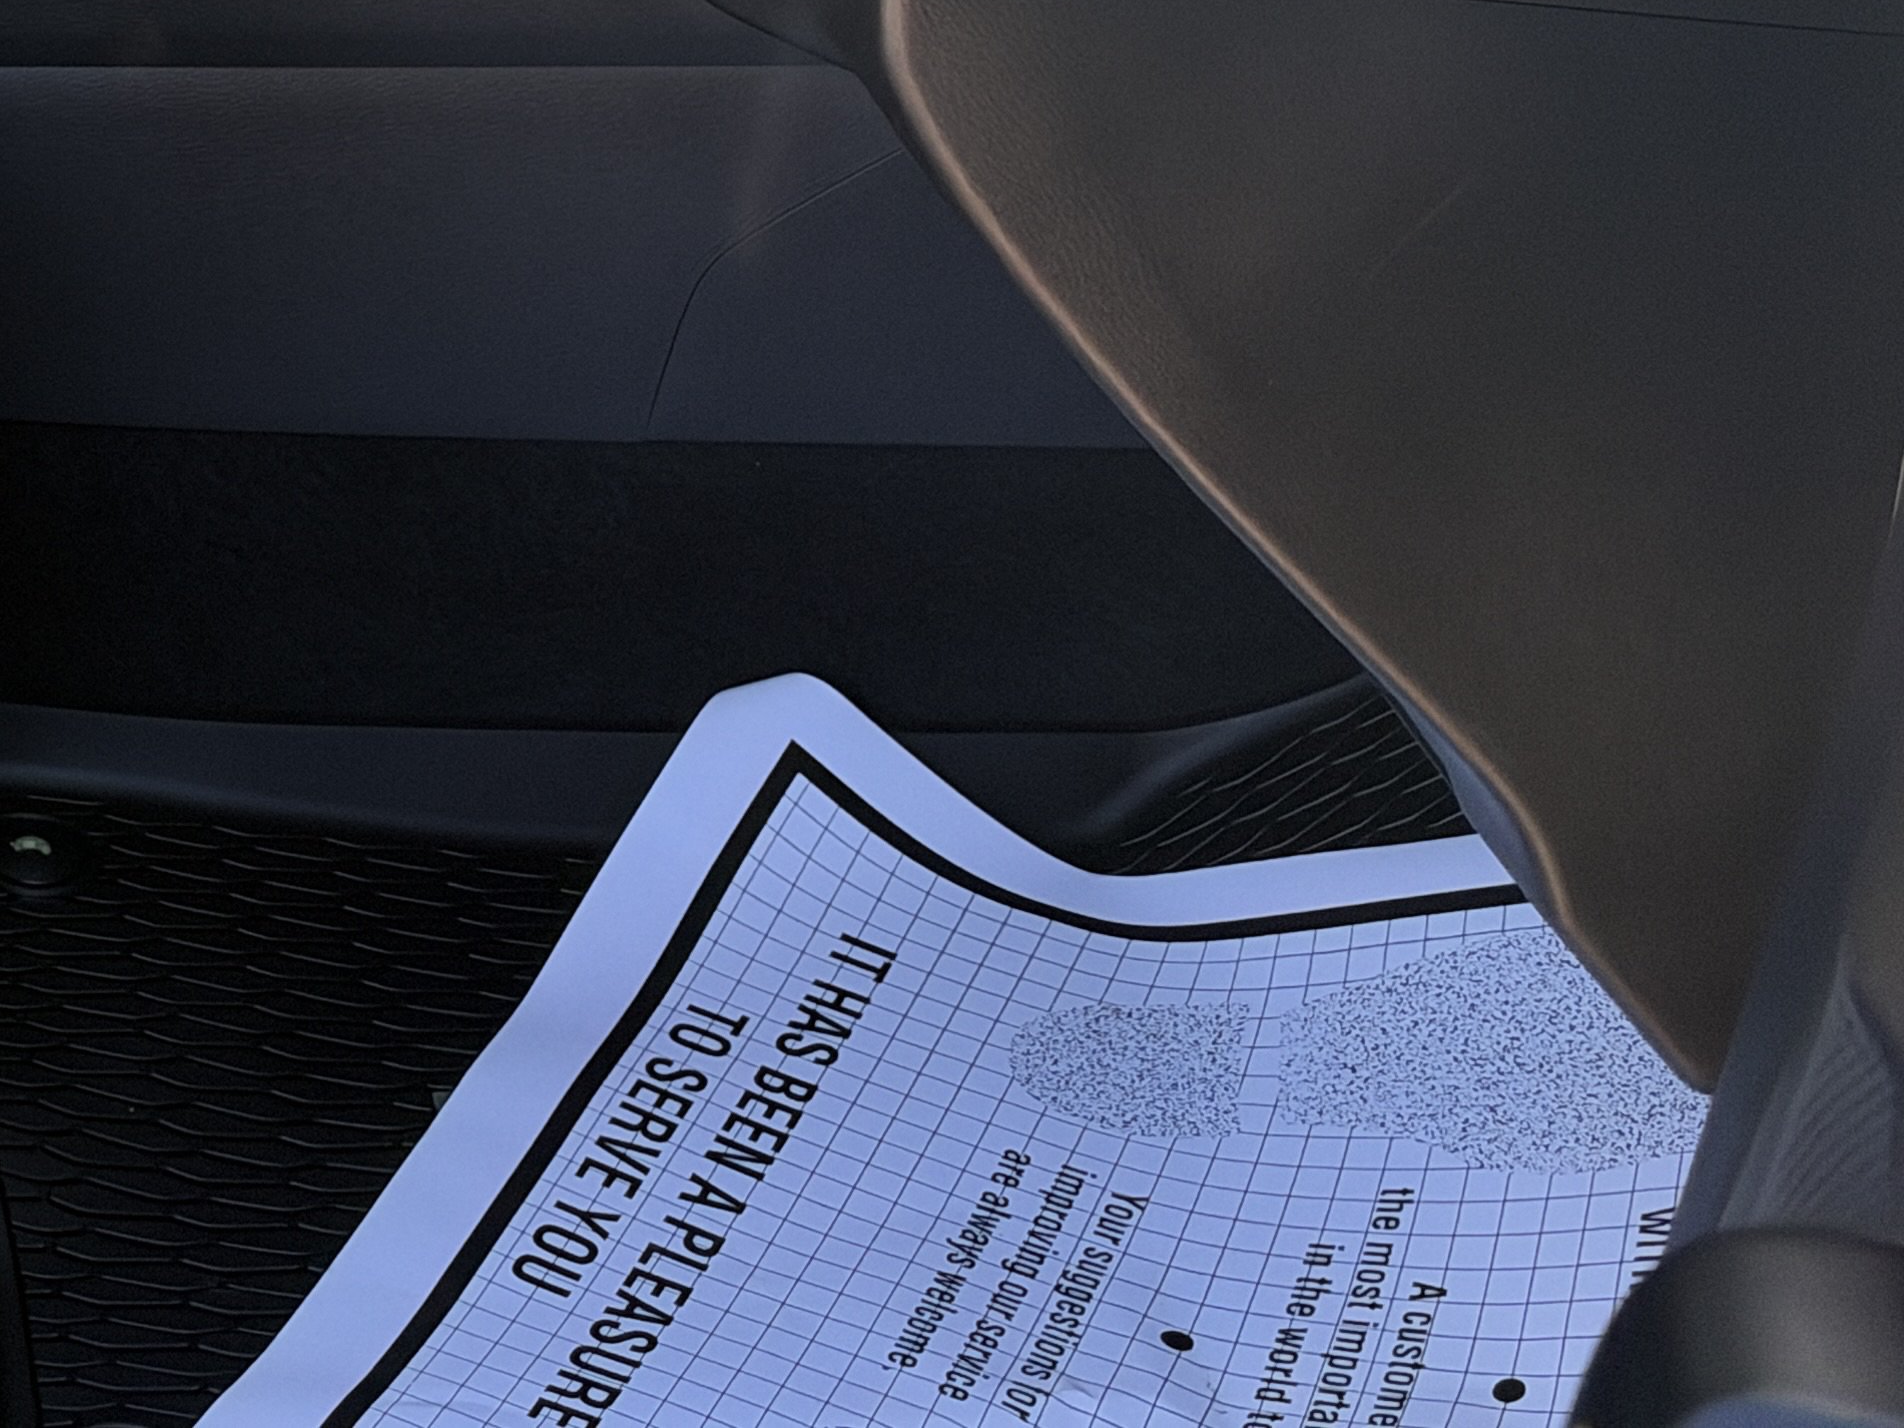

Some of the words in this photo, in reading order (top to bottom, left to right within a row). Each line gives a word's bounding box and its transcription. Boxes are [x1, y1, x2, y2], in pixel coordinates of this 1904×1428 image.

[829, 932, 898, 983] IT
[667, 1004, 750, 1058] TO
[775, 979, 871, 1067] HAS
[574, 1057, 709, 1199] SERVE
[704, 1065, 818, 1182] BEEN
[678, 1173, 746, 1214] A
[991, 1148, 1031, 1189] are
[946, 1191, 1013, 1270] always
[1000, 1164, 1097, 1280] improving
[1093, 1191, 1150, 1246] Your
[1371, 1187, 1415, 1231] the
[511, 1200, 622, 1298] YOU
[1303, 1242, 1345, 1267] in
[1347, 1242, 1394, 1310] most
[527, 1215, 727, 1428] PLEASURE
[989, 1280, 1029, 1322] our
[1020, 1246, 1114, 1380] suggestions
[1286, 1277, 1332, 1317] the
[1409, 1281, 1447, 1301] A
[938, 1318, 1006, 1402] service
[1254, 1328, 1309, 1404] world
[1304, 1319, 1380, 1428] importa
[1001, 1379, 1051, 1423] for
